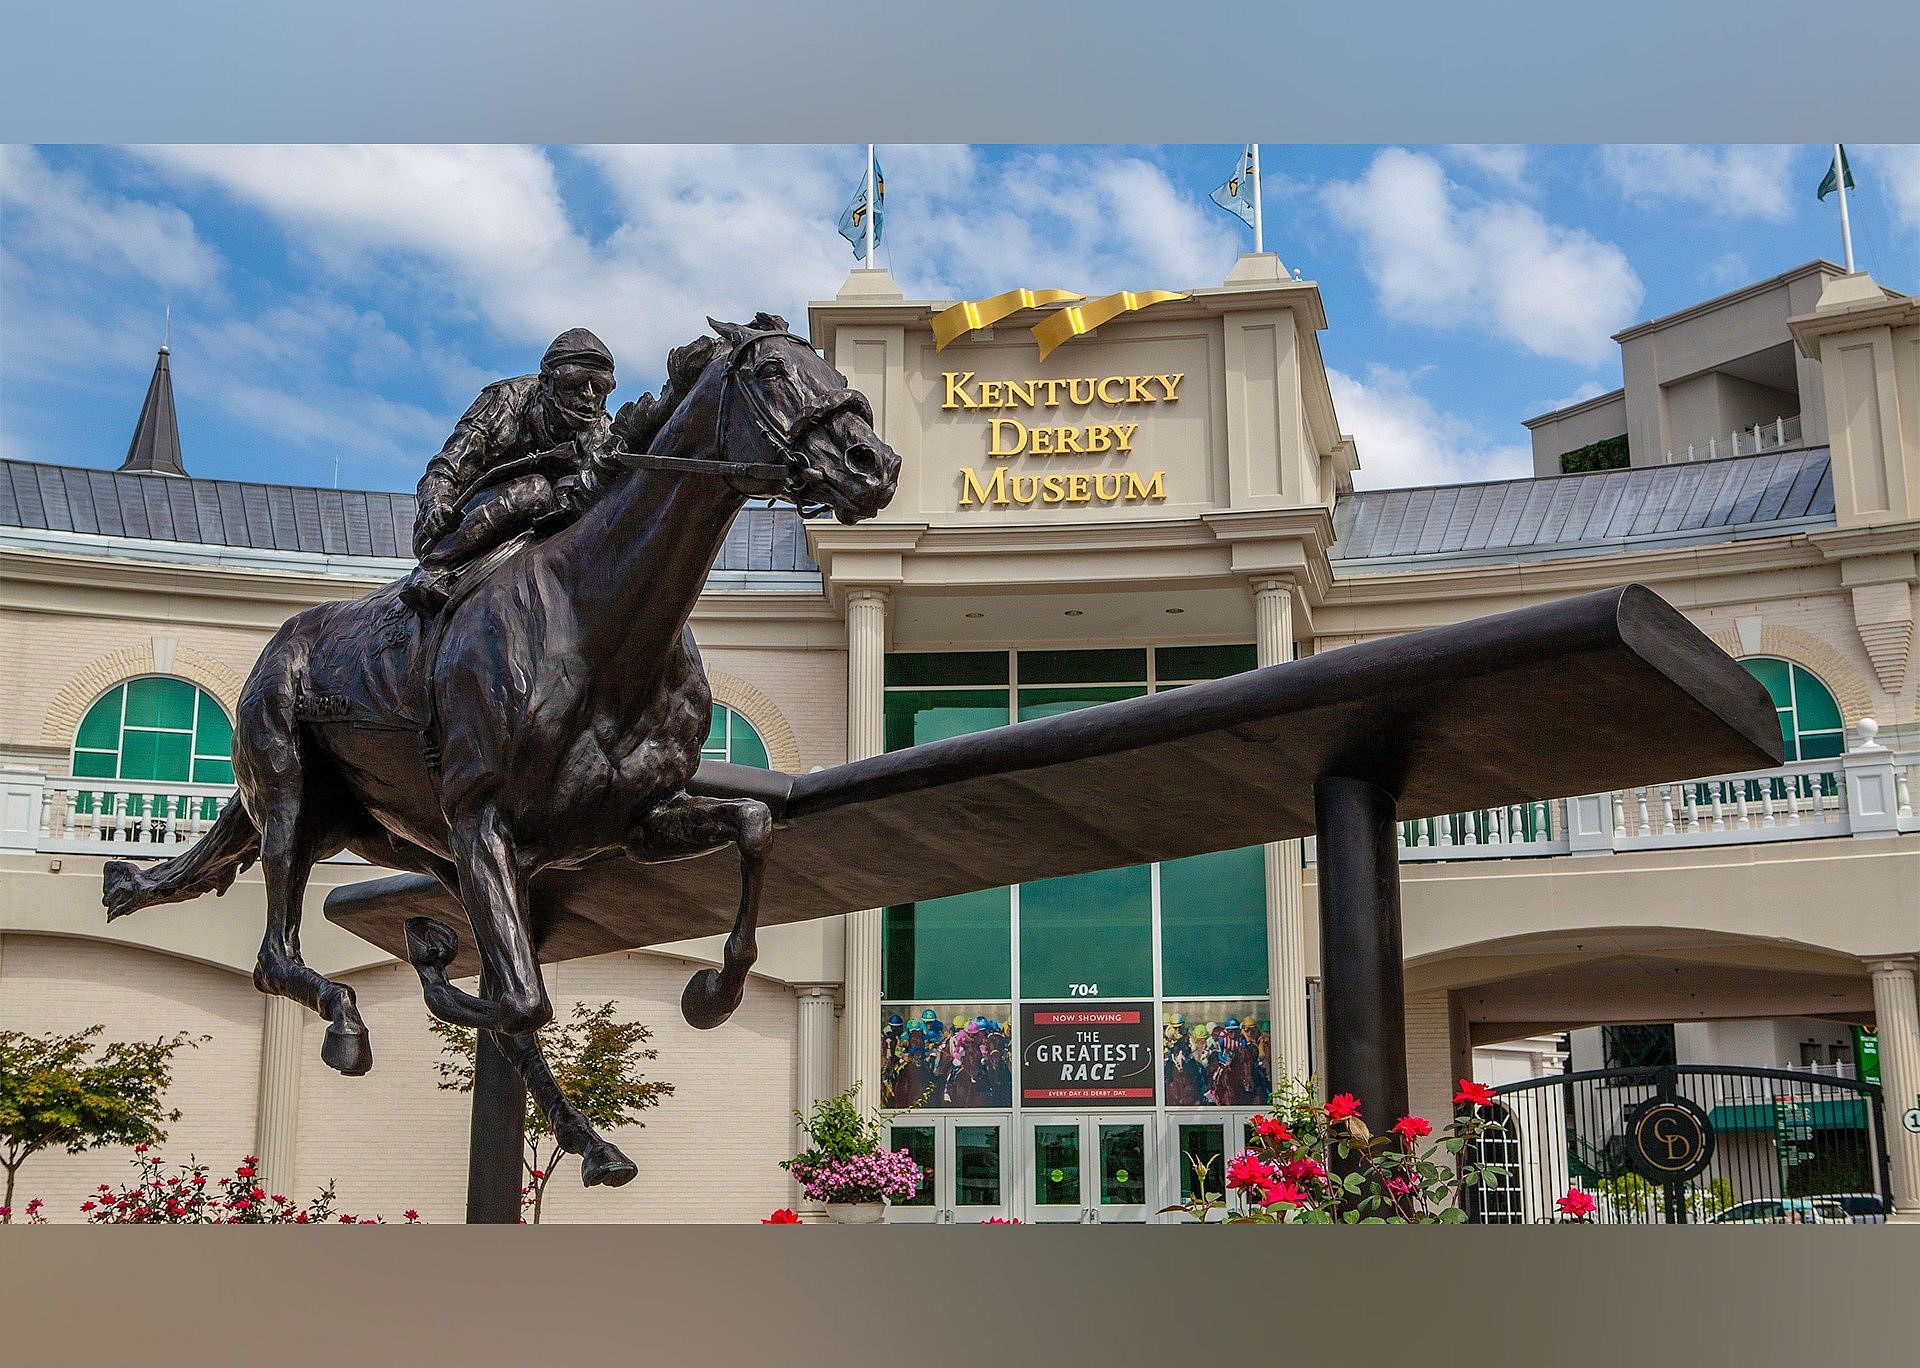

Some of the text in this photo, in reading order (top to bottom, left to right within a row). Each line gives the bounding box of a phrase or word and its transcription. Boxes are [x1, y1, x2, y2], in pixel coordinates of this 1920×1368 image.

[941, 371, 1184, 409] KENTUCKY
[987, 418, 1138, 456] DERBY
[959, 466, 1167, 505] MUSEUM
[1069, 984, 1098, 996] 704
[1052, 1014, 1122, 1022] NOW SHOWING
[1076, 1031, 1100, 1043] THE
[1036, 1044, 1140, 1062] GREATEST
[1060, 1063, 1117, 1081] RACE
